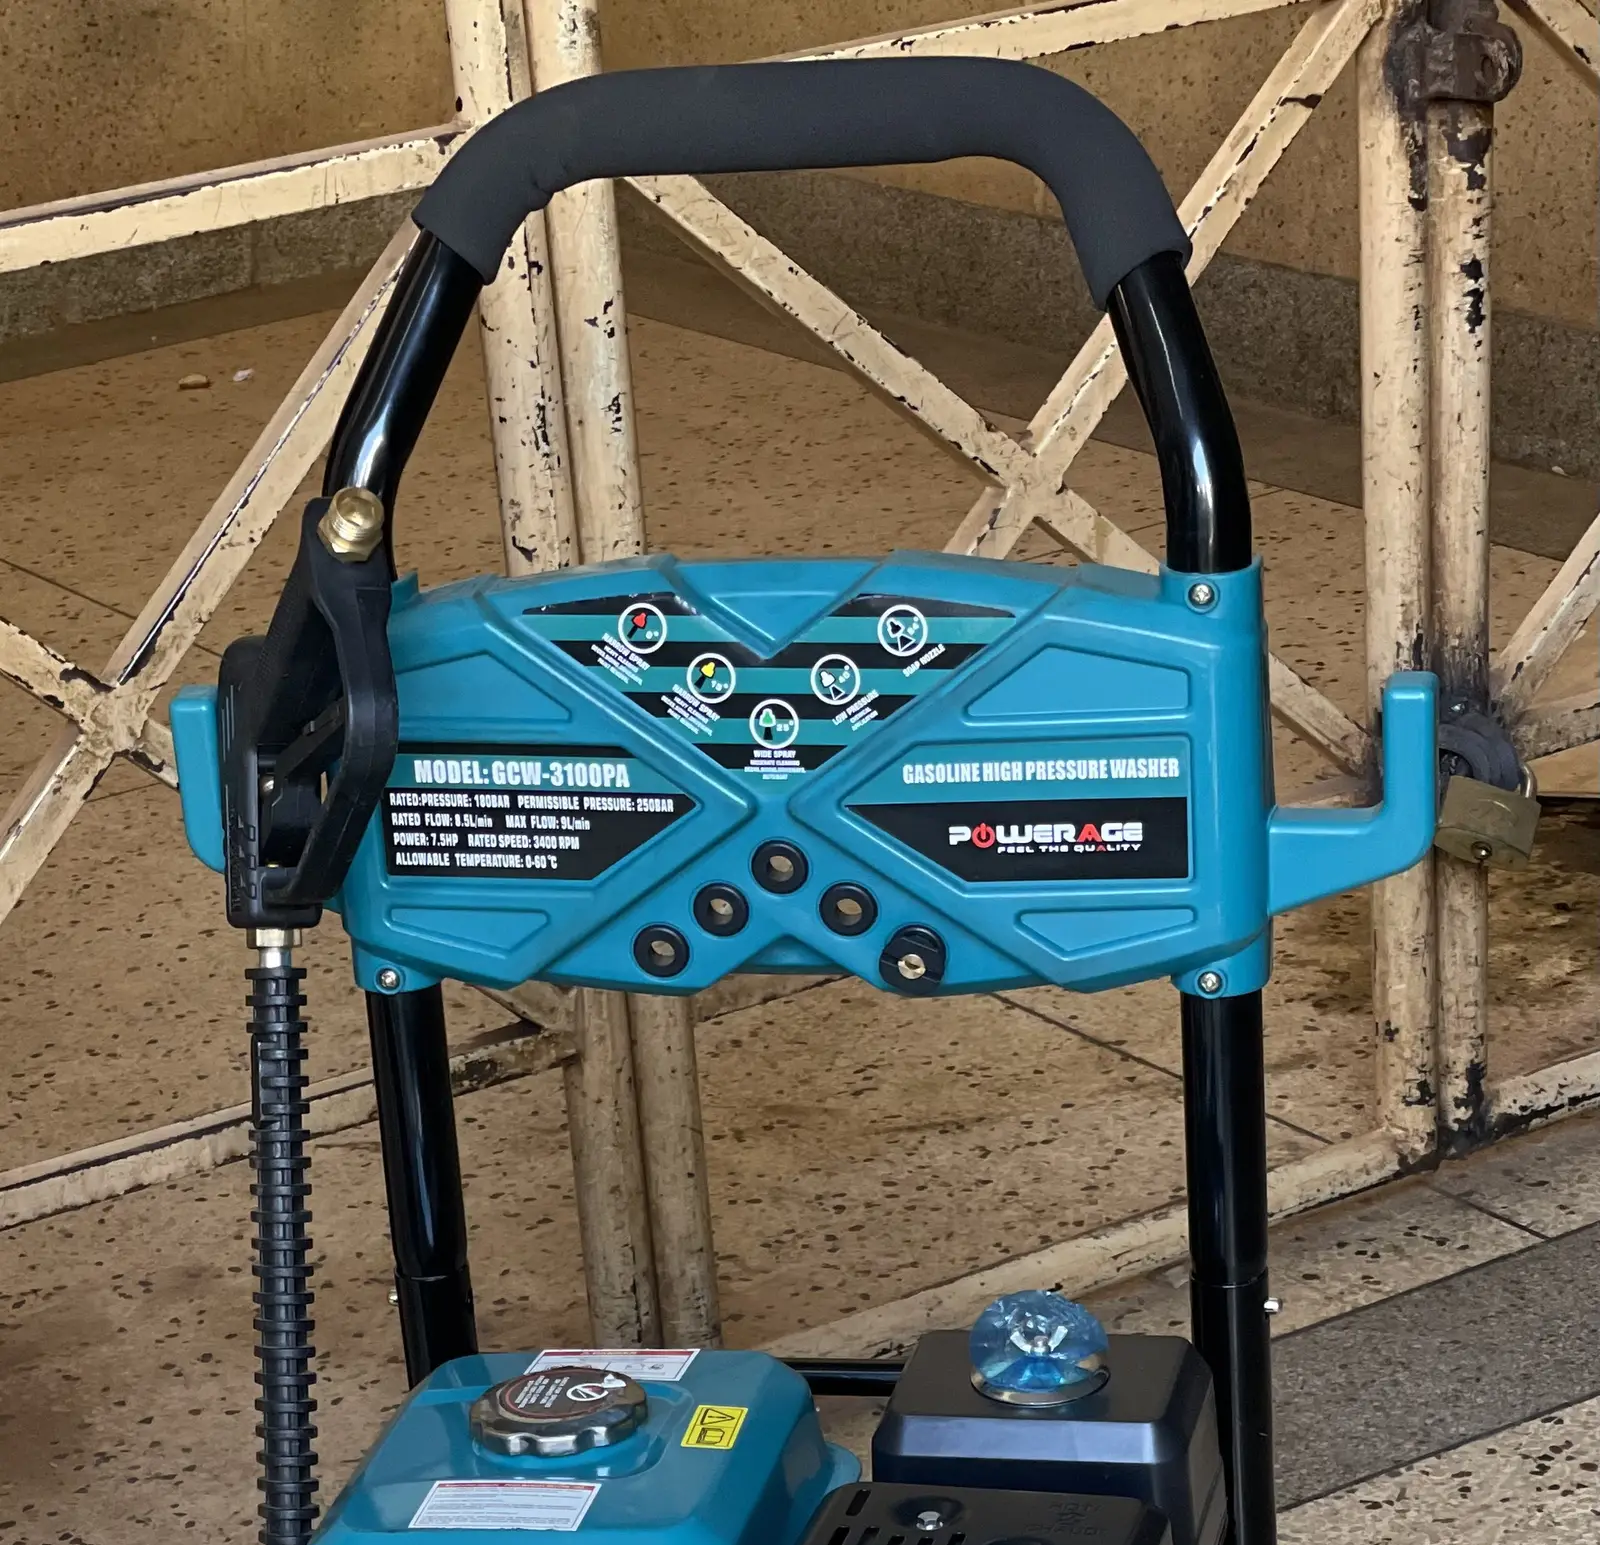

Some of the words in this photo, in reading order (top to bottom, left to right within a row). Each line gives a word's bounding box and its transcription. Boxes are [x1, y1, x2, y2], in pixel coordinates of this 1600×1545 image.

[628, 652, 650, 671] SPRAY
[902, 660, 920, 678] SOAP
[919, 643, 946, 665] NOZZLE
[672, 684, 699, 708] NARROW
[698, 704, 720, 722] SPRAY
[832, 710, 848, 726] LOW
[846, 689, 880, 716] PRESSURE
[753, 749, 772, 759] WIDE
[773, 749, 796, 759] SPRAY
[902, 763, 981, 785] GASOLINE
[983, 761, 1023, 783] HIGH
[1025, 759, 1108, 782] PRESSURE
[1110, 757, 1180, 779] WASHER
[474, 793, 510, 809] 180BAR
[517, 795, 580, 811] PERMISSIBLE
[583, 796, 636, 812] PRESSURE:
[636, 797, 675, 813] 250BAR
[391, 812, 421, 827] RATED
[424, 812, 453, 827] FLOW:
[454, 813, 493, 829] 8.5L/min
[505, 814, 527, 829] MAX
[530, 815, 560, 830] FLOW:
[560, 815, 591, 831] 9L/min
[393, 832, 430, 847] POWER:
[430, 832, 459, 847] 7.5HP
[467, 833, 497, 847] RATED
[498, 833, 532, 849] SPEED:
[533, 835, 557, 850] 3400
[558, 835, 580, 850] RPM
[948, 822, 1143, 849] POWERAGE
[997, 845, 1035, 854] FEEL
[1038, 845, 1069, 853] THE
[1073, 843, 1142, 854] QUALITY
[396, 851, 450, 867] ALLOWABLE
[454, 852, 524, 869] TEMPERATURE:
